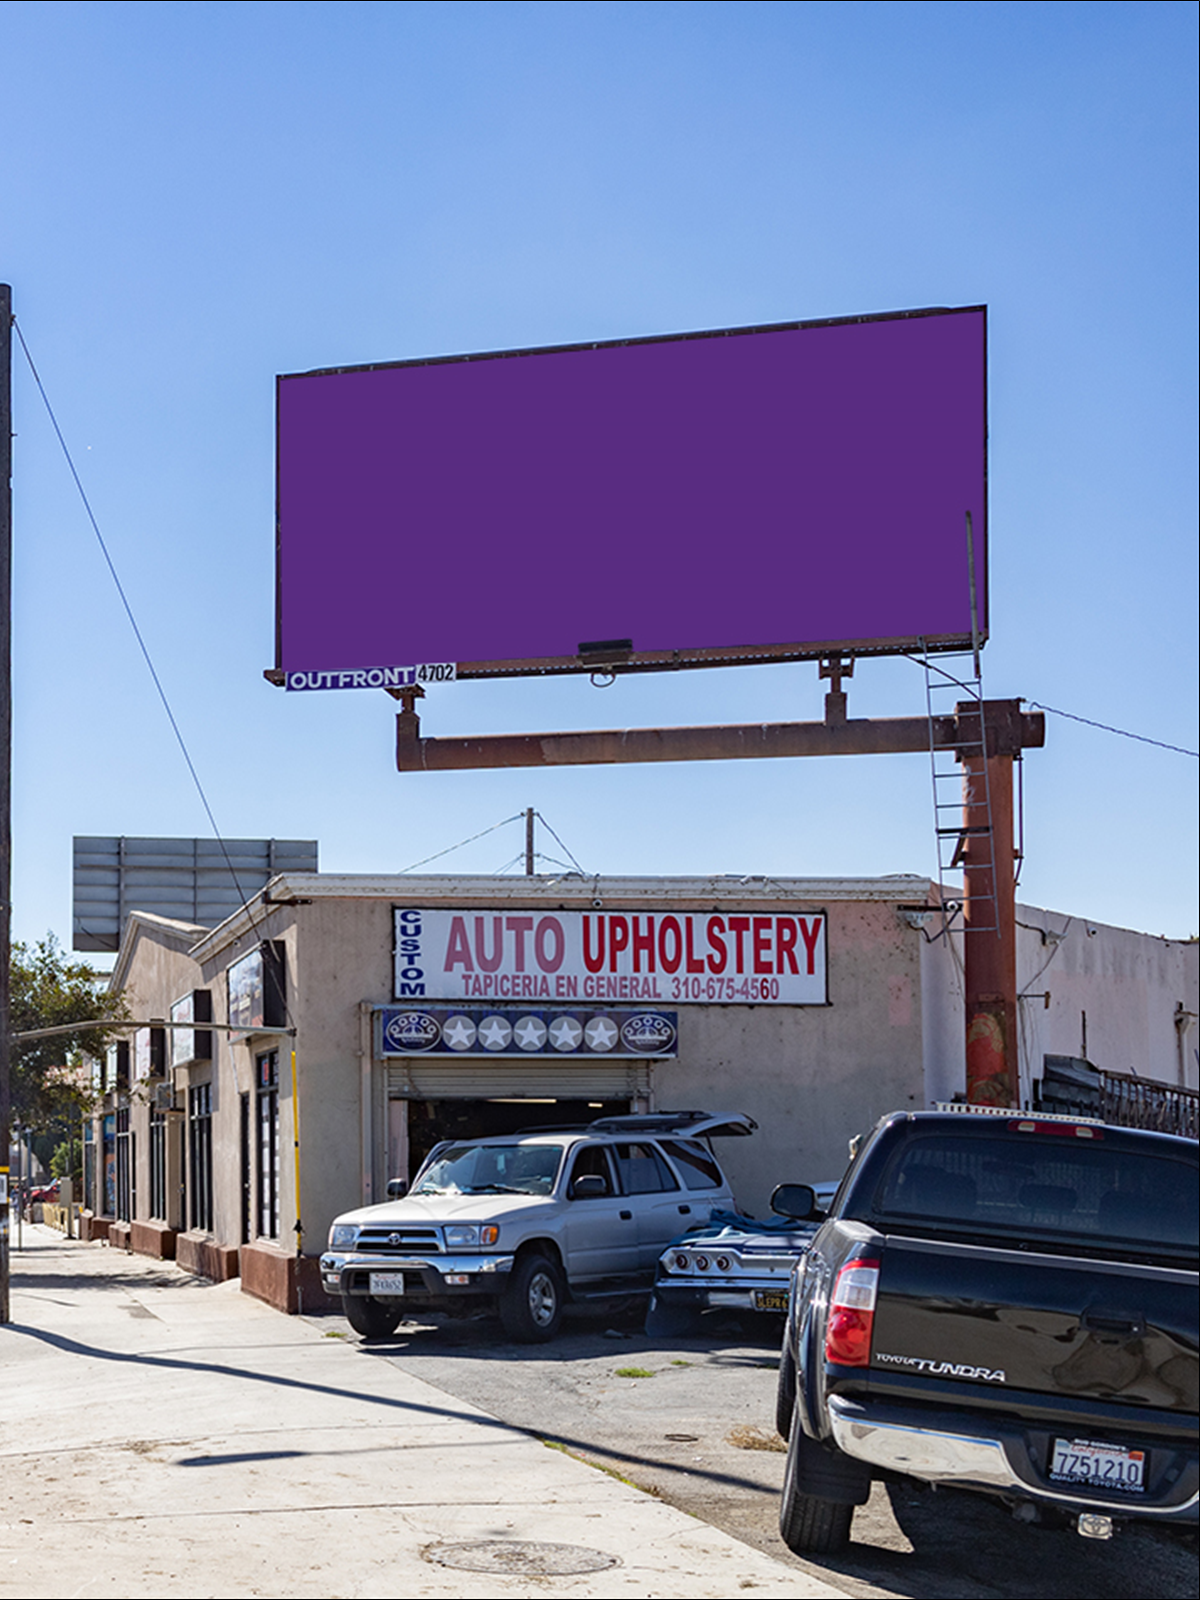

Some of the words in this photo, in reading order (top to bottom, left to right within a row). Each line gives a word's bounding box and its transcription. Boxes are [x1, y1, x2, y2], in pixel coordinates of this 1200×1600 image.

[289, 667, 415, 689] OUTFRONT
[418, 664, 454, 682] 4702
[399, 910, 426, 997] CUSTOM
[443, 915, 565, 974] AUTO
[581, 914, 823, 976] UPHOLSTERY
[461, 973, 553, 998] TAPICERIA
[555, 974, 579, 998] EN
[582, 974, 662, 1000] GENERAL
[671, 975, 780, 1001] 310-675-4560
[876, 1352, 916, 1366] TOYOTA
[914, 1358, 1006, 1382] TUNDRA
[1049, 1473, 1086, 1484] QUALITY
[1056, 1451, 1140, 1486] 7Z51210
